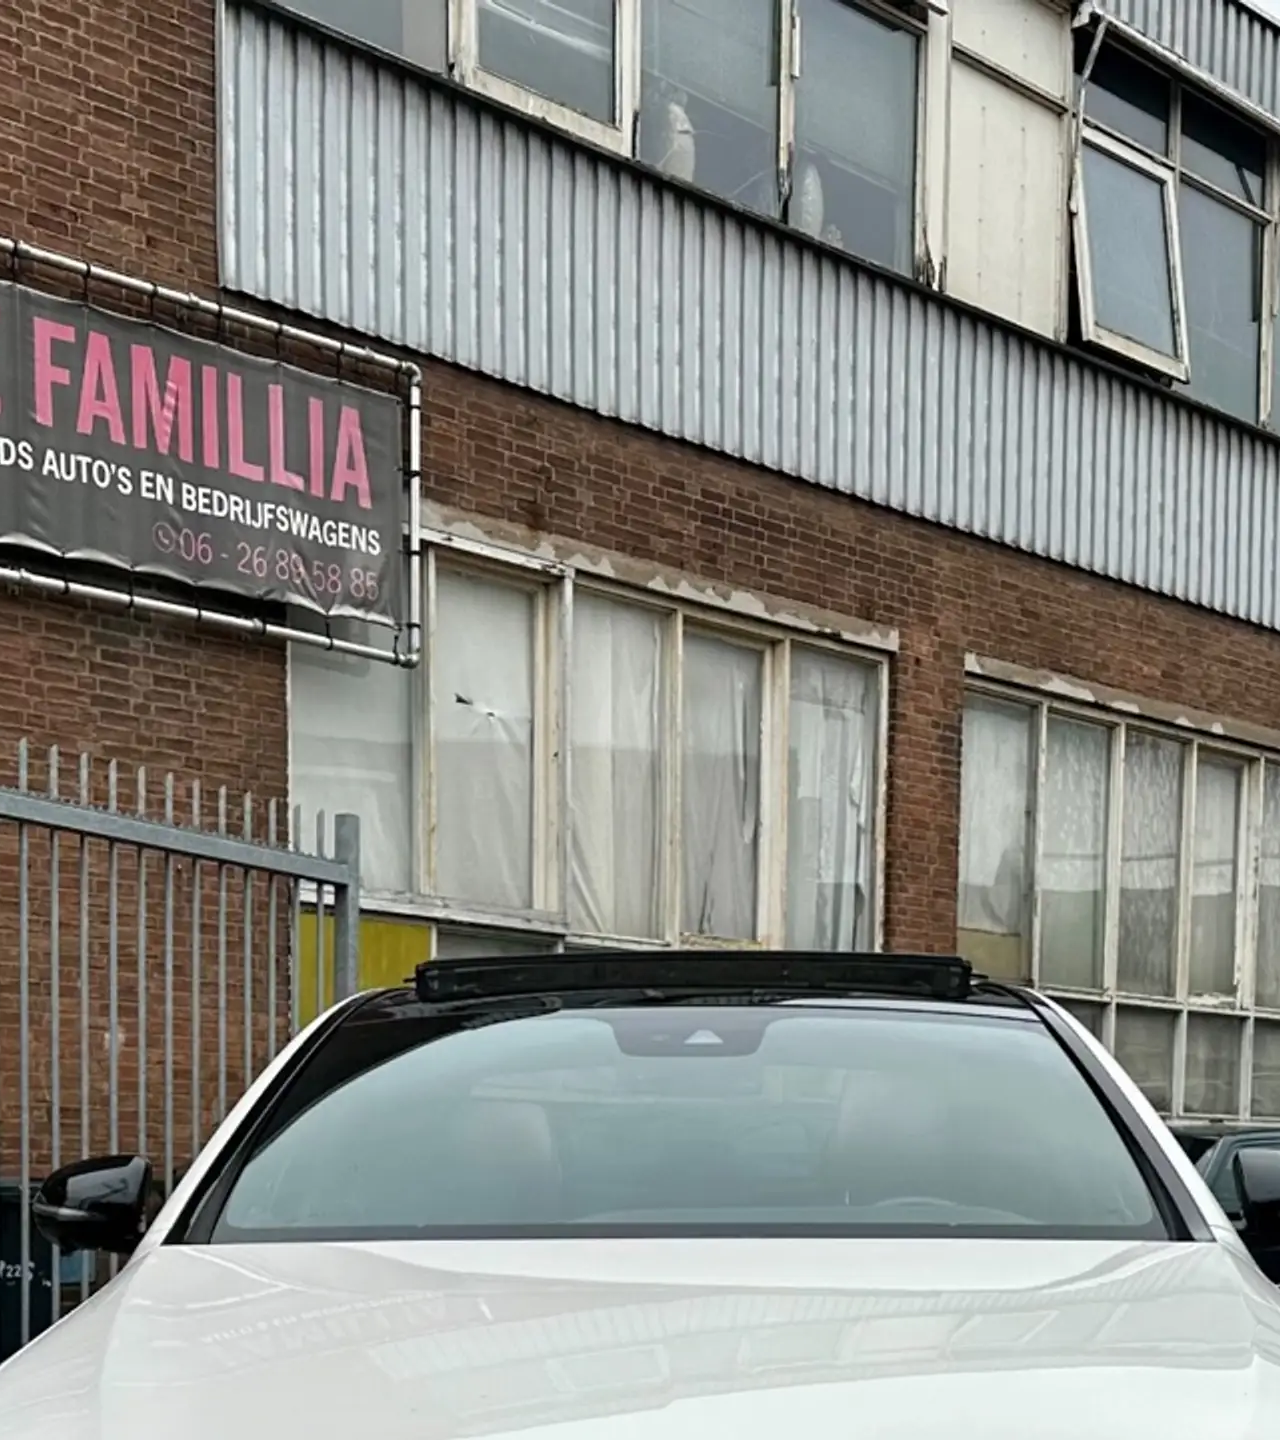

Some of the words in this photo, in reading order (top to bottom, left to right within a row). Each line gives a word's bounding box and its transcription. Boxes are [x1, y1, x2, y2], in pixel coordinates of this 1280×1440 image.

[32, 316, 373, 509] FAMILLIA
[42, 448, 134, 495] AUTO'S
[140, 470, 174, 506] EN
[181, 482, 382, 556] BEDRIJFSWAGENS
[178, 528, 213, 564] 06
[236, 541, 269, 577] 26
[312, 560, 342, 594] 58
[349, 567, 379, 600] 85
